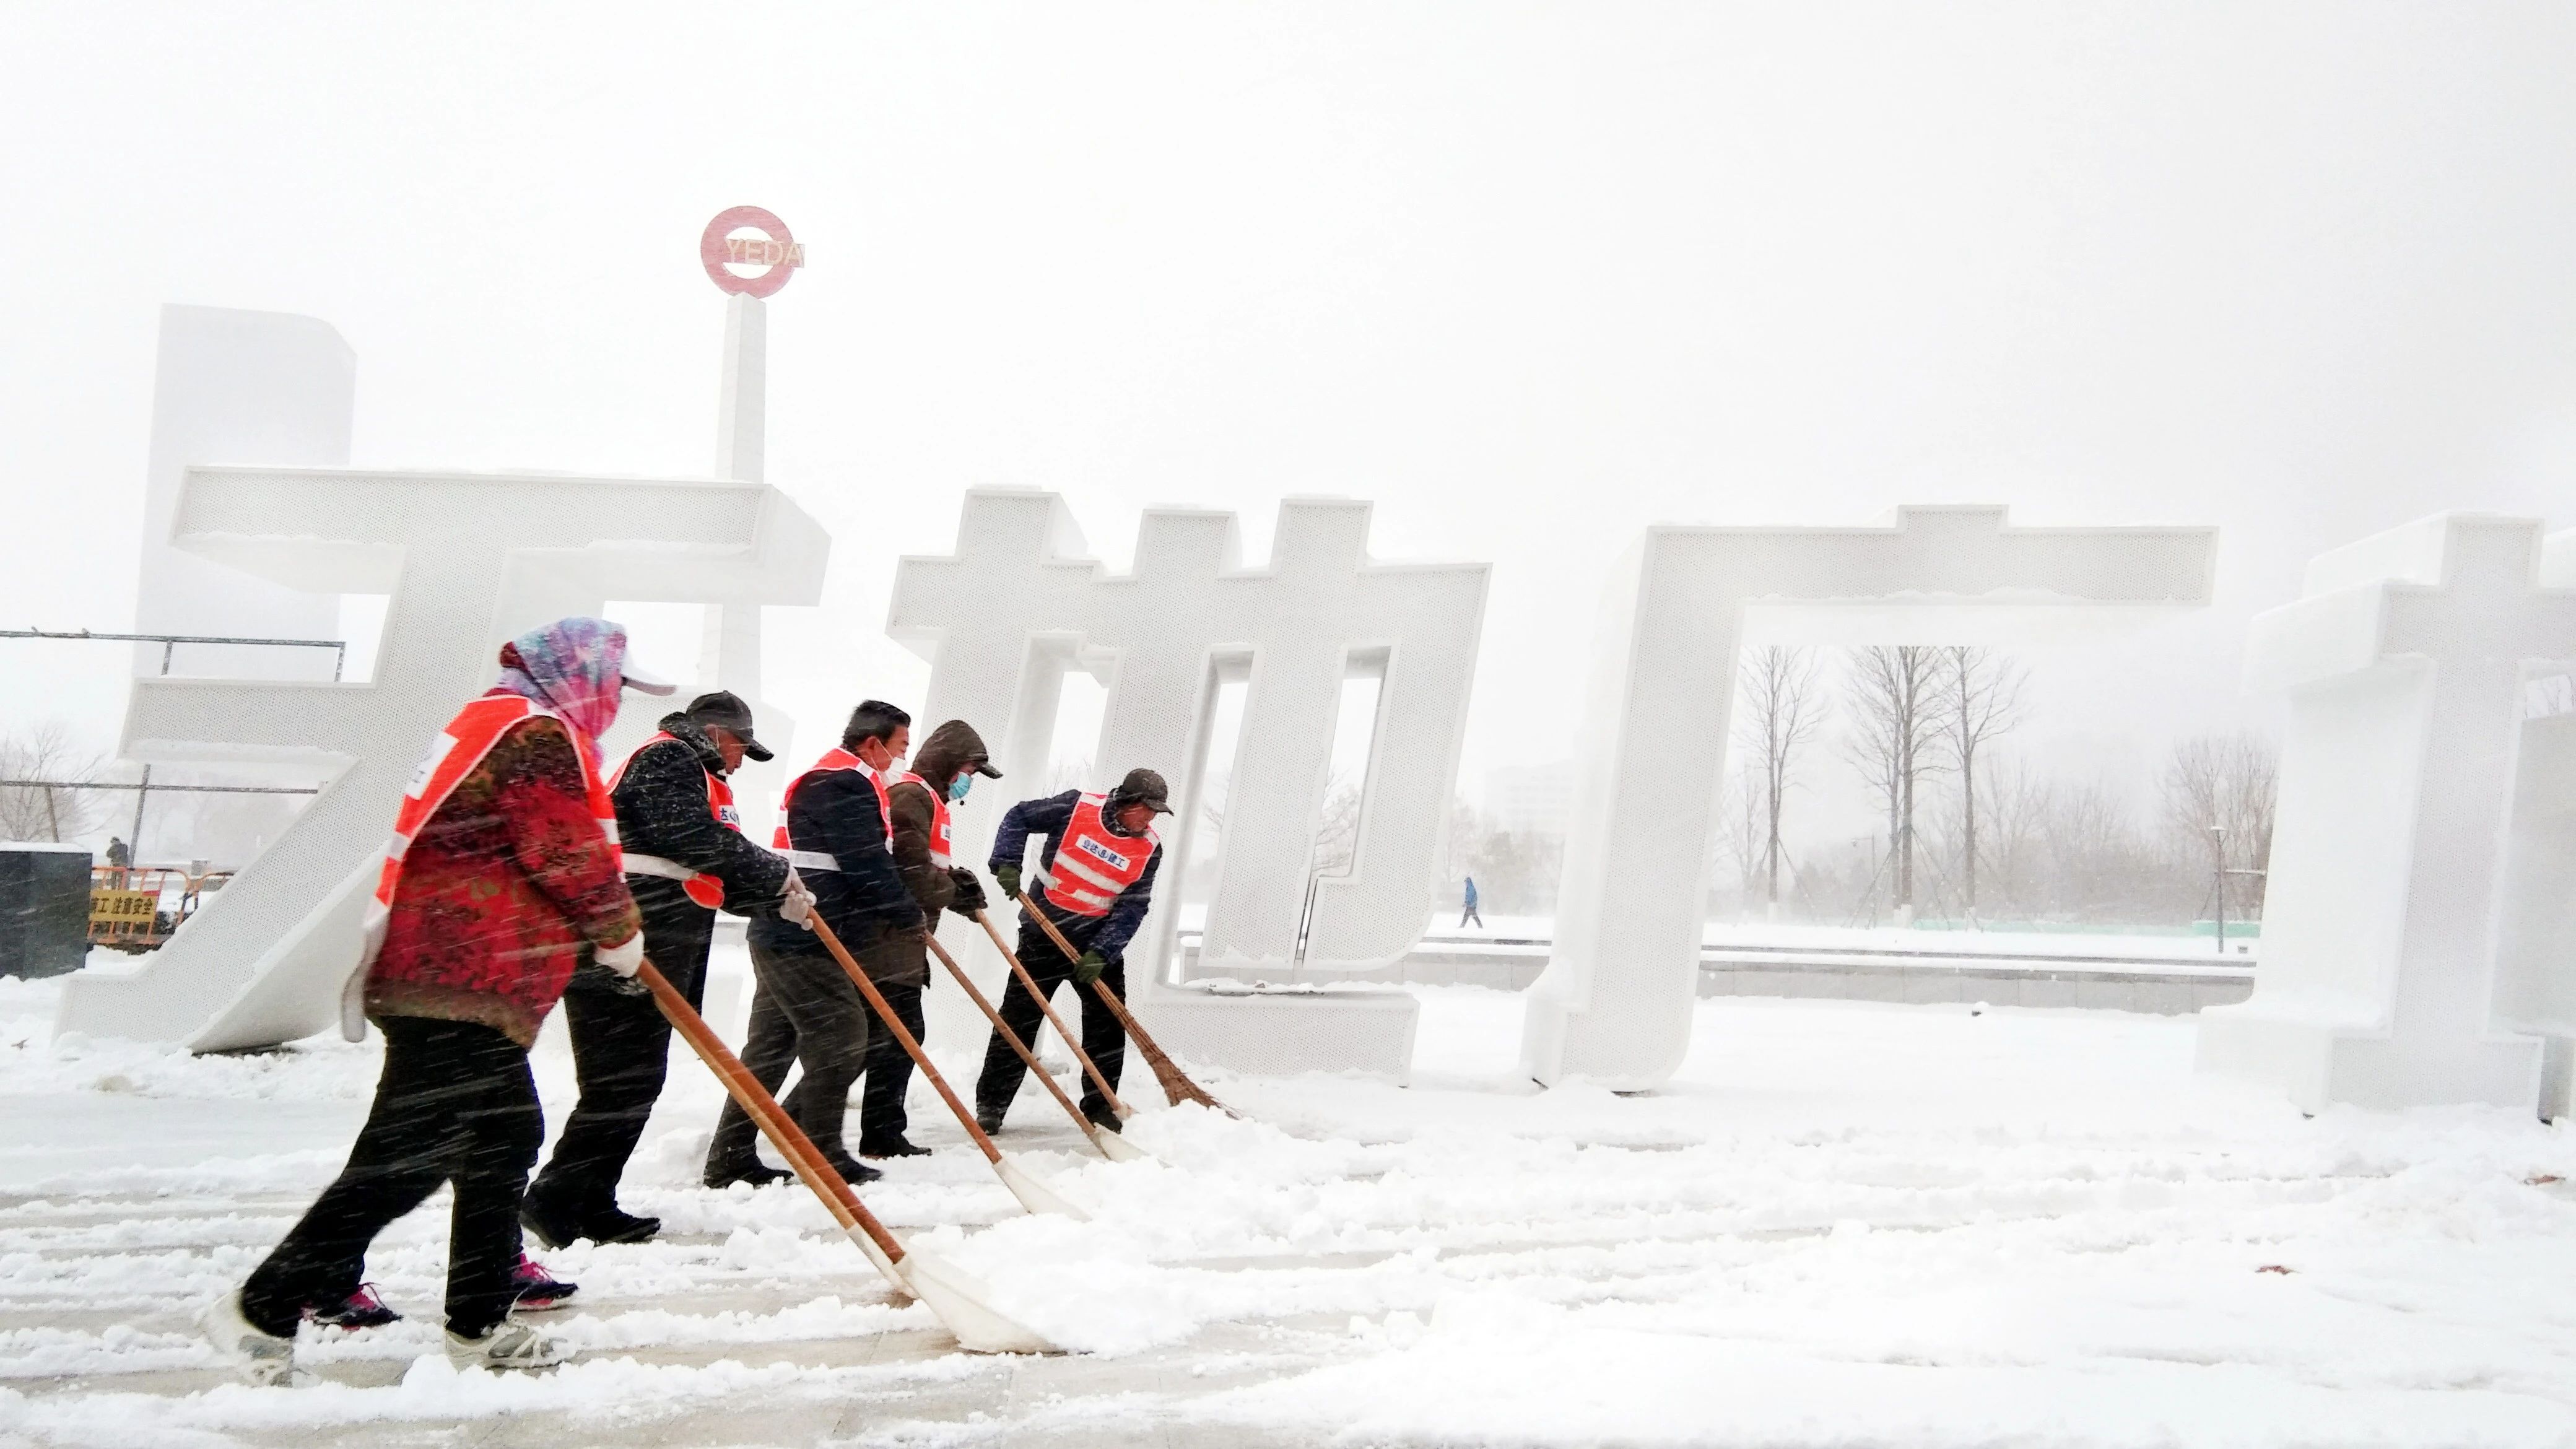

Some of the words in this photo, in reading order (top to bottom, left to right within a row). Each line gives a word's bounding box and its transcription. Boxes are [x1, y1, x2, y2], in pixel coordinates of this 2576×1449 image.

[724, 238, 804, 268] YEDA
[111, 897, 153, 915] 注意安全
